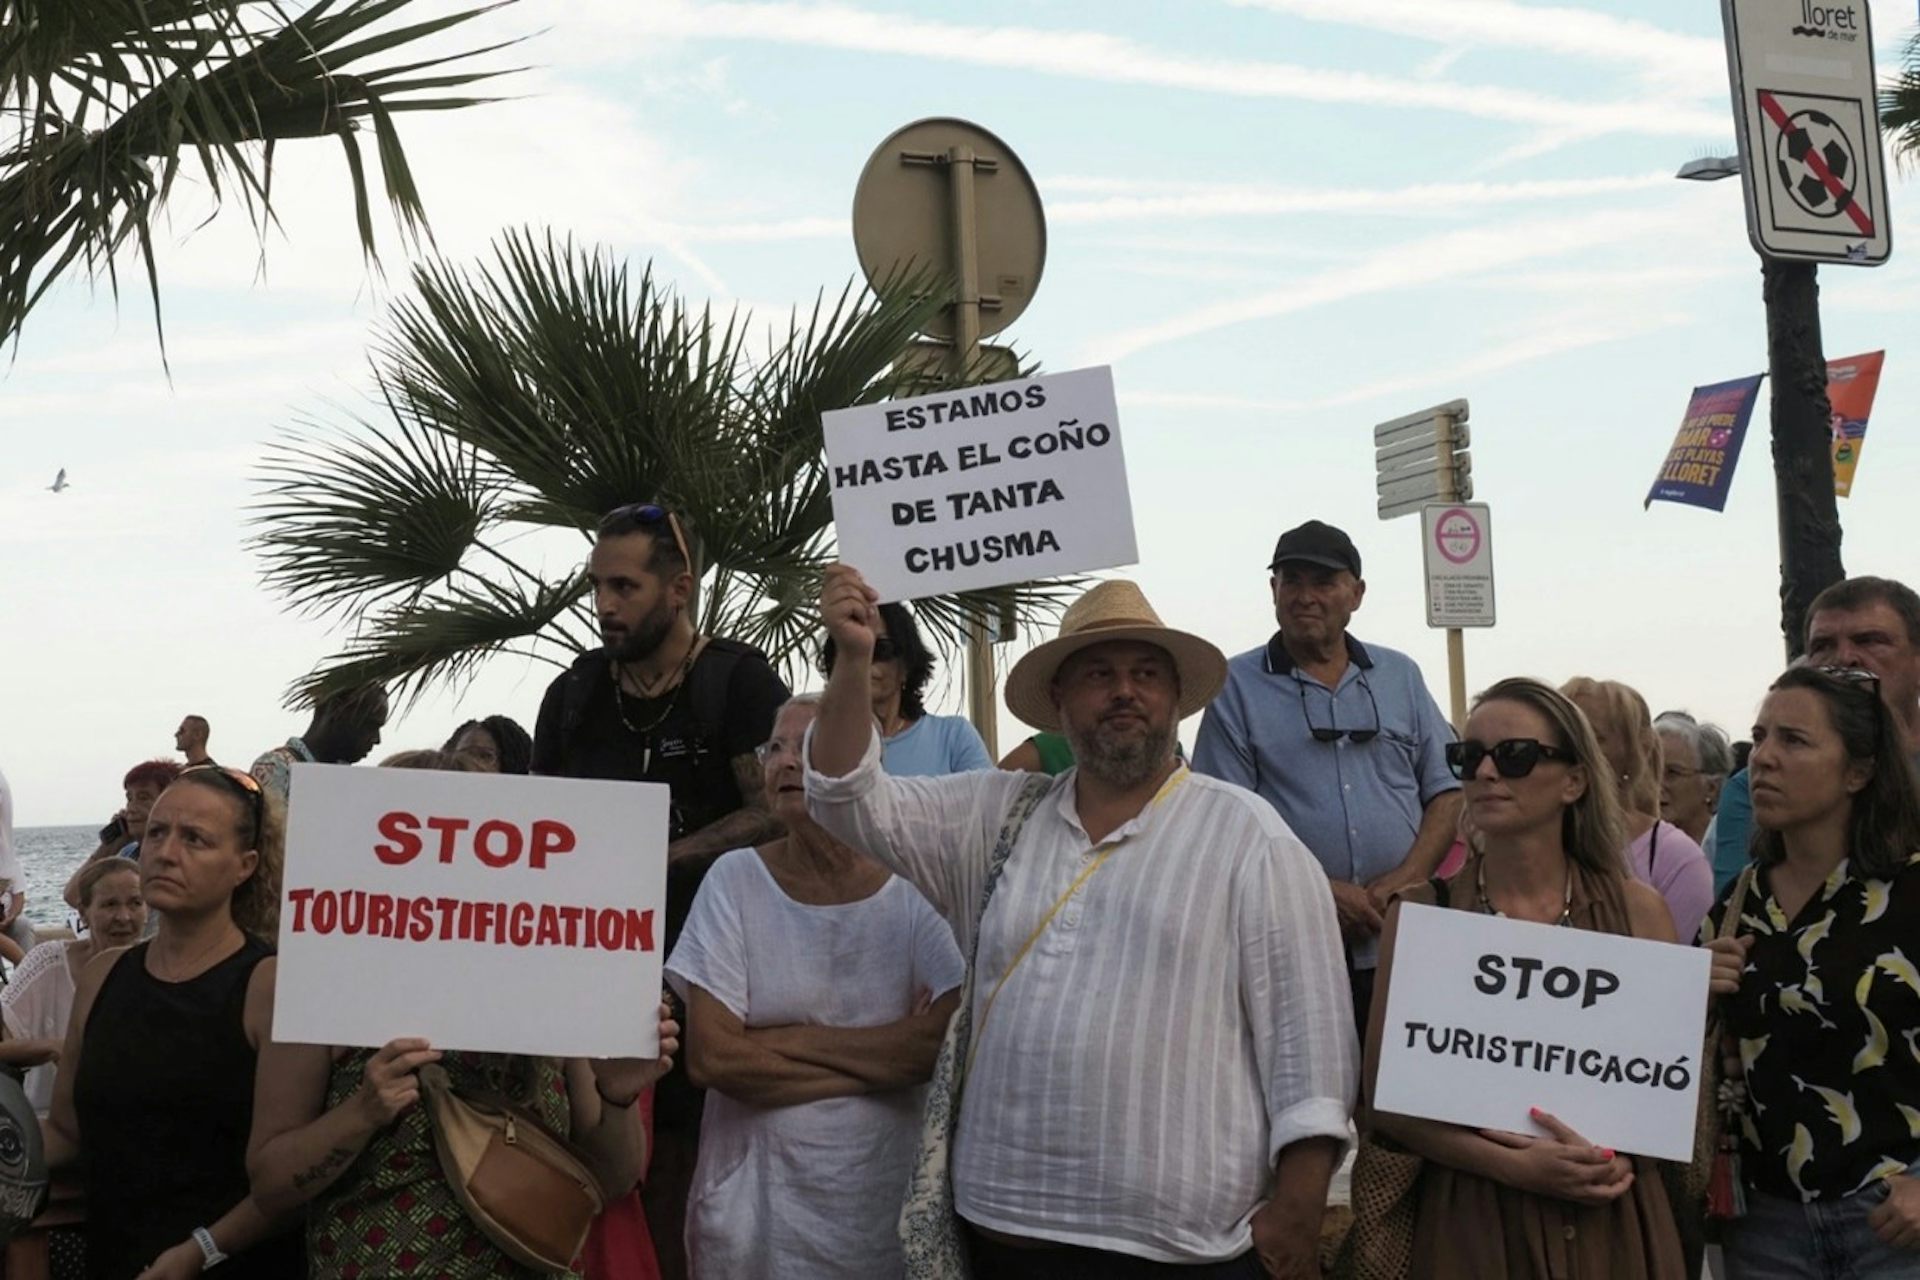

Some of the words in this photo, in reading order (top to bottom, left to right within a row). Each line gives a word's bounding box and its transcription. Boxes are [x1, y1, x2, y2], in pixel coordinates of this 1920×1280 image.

[1801, 0, 1857, 30] lloret
[885, 384, 1047, 432] ESTAMOS
[835, 451, 949, 488] HASTA
[958, 443, 1001, 472] EL
[1007, 418, 1111, 460] COÑO
[1663, 461, 1721, 487] LLORET
[892, 499, 937, 527] DE
[946, 479, 1065, 520] TANTA
[904, 530, 1061, 574] CHUSMA
[373, 811, 577, 870] STOP
[288, 888, 655, 952] TOURISTIFICATION
[1473, 954, 1621, 1009] STOP
[1404, 1021, 1691, 1091] TURISTIFICACIÓ
